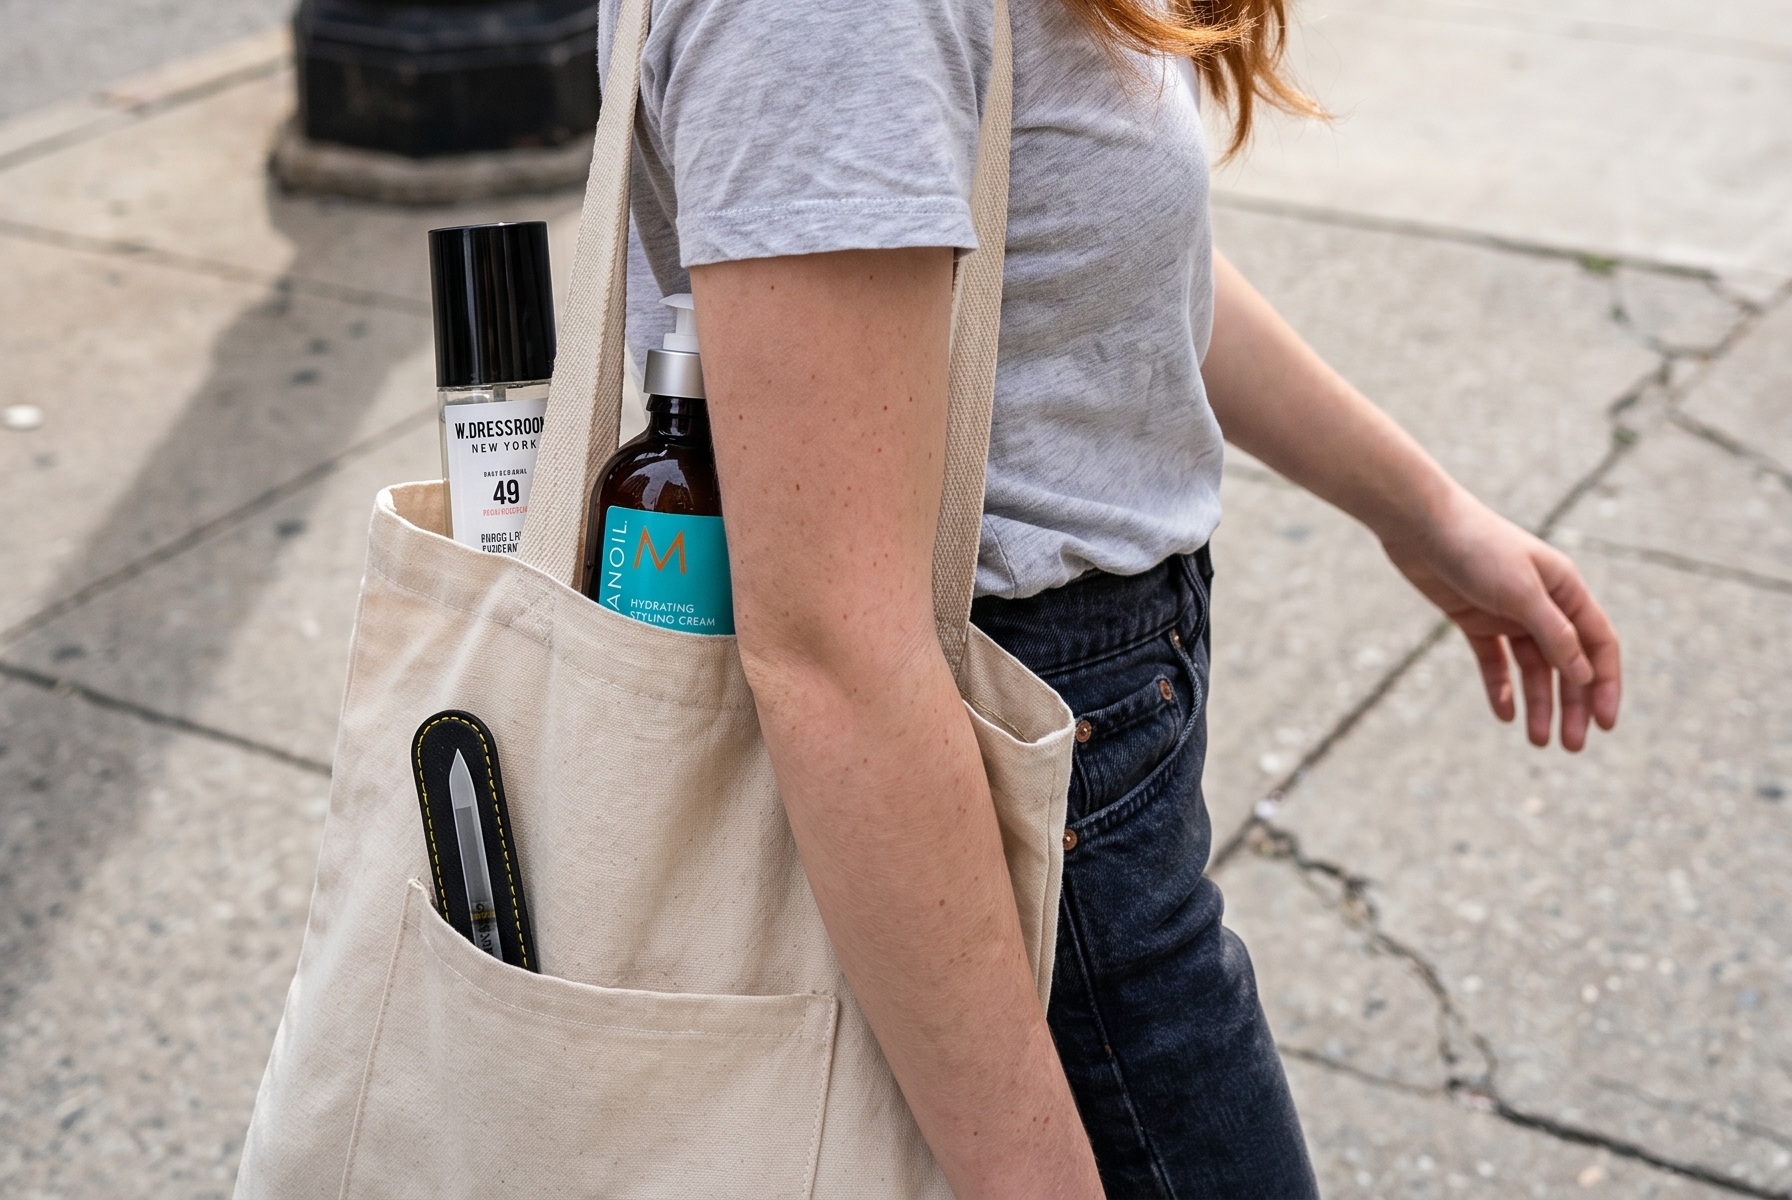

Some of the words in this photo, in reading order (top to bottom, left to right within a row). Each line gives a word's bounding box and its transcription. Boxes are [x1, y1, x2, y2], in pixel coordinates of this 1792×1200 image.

[472, 443, 498, 453] NEW
[504, 439, 537, 451] YORK
[493, 479, 520, 504] 49
[633, 525, 687, 575] M
[630, 598, 694, 613] HYDRATING
[678, 616, 715, 627] CREAM
